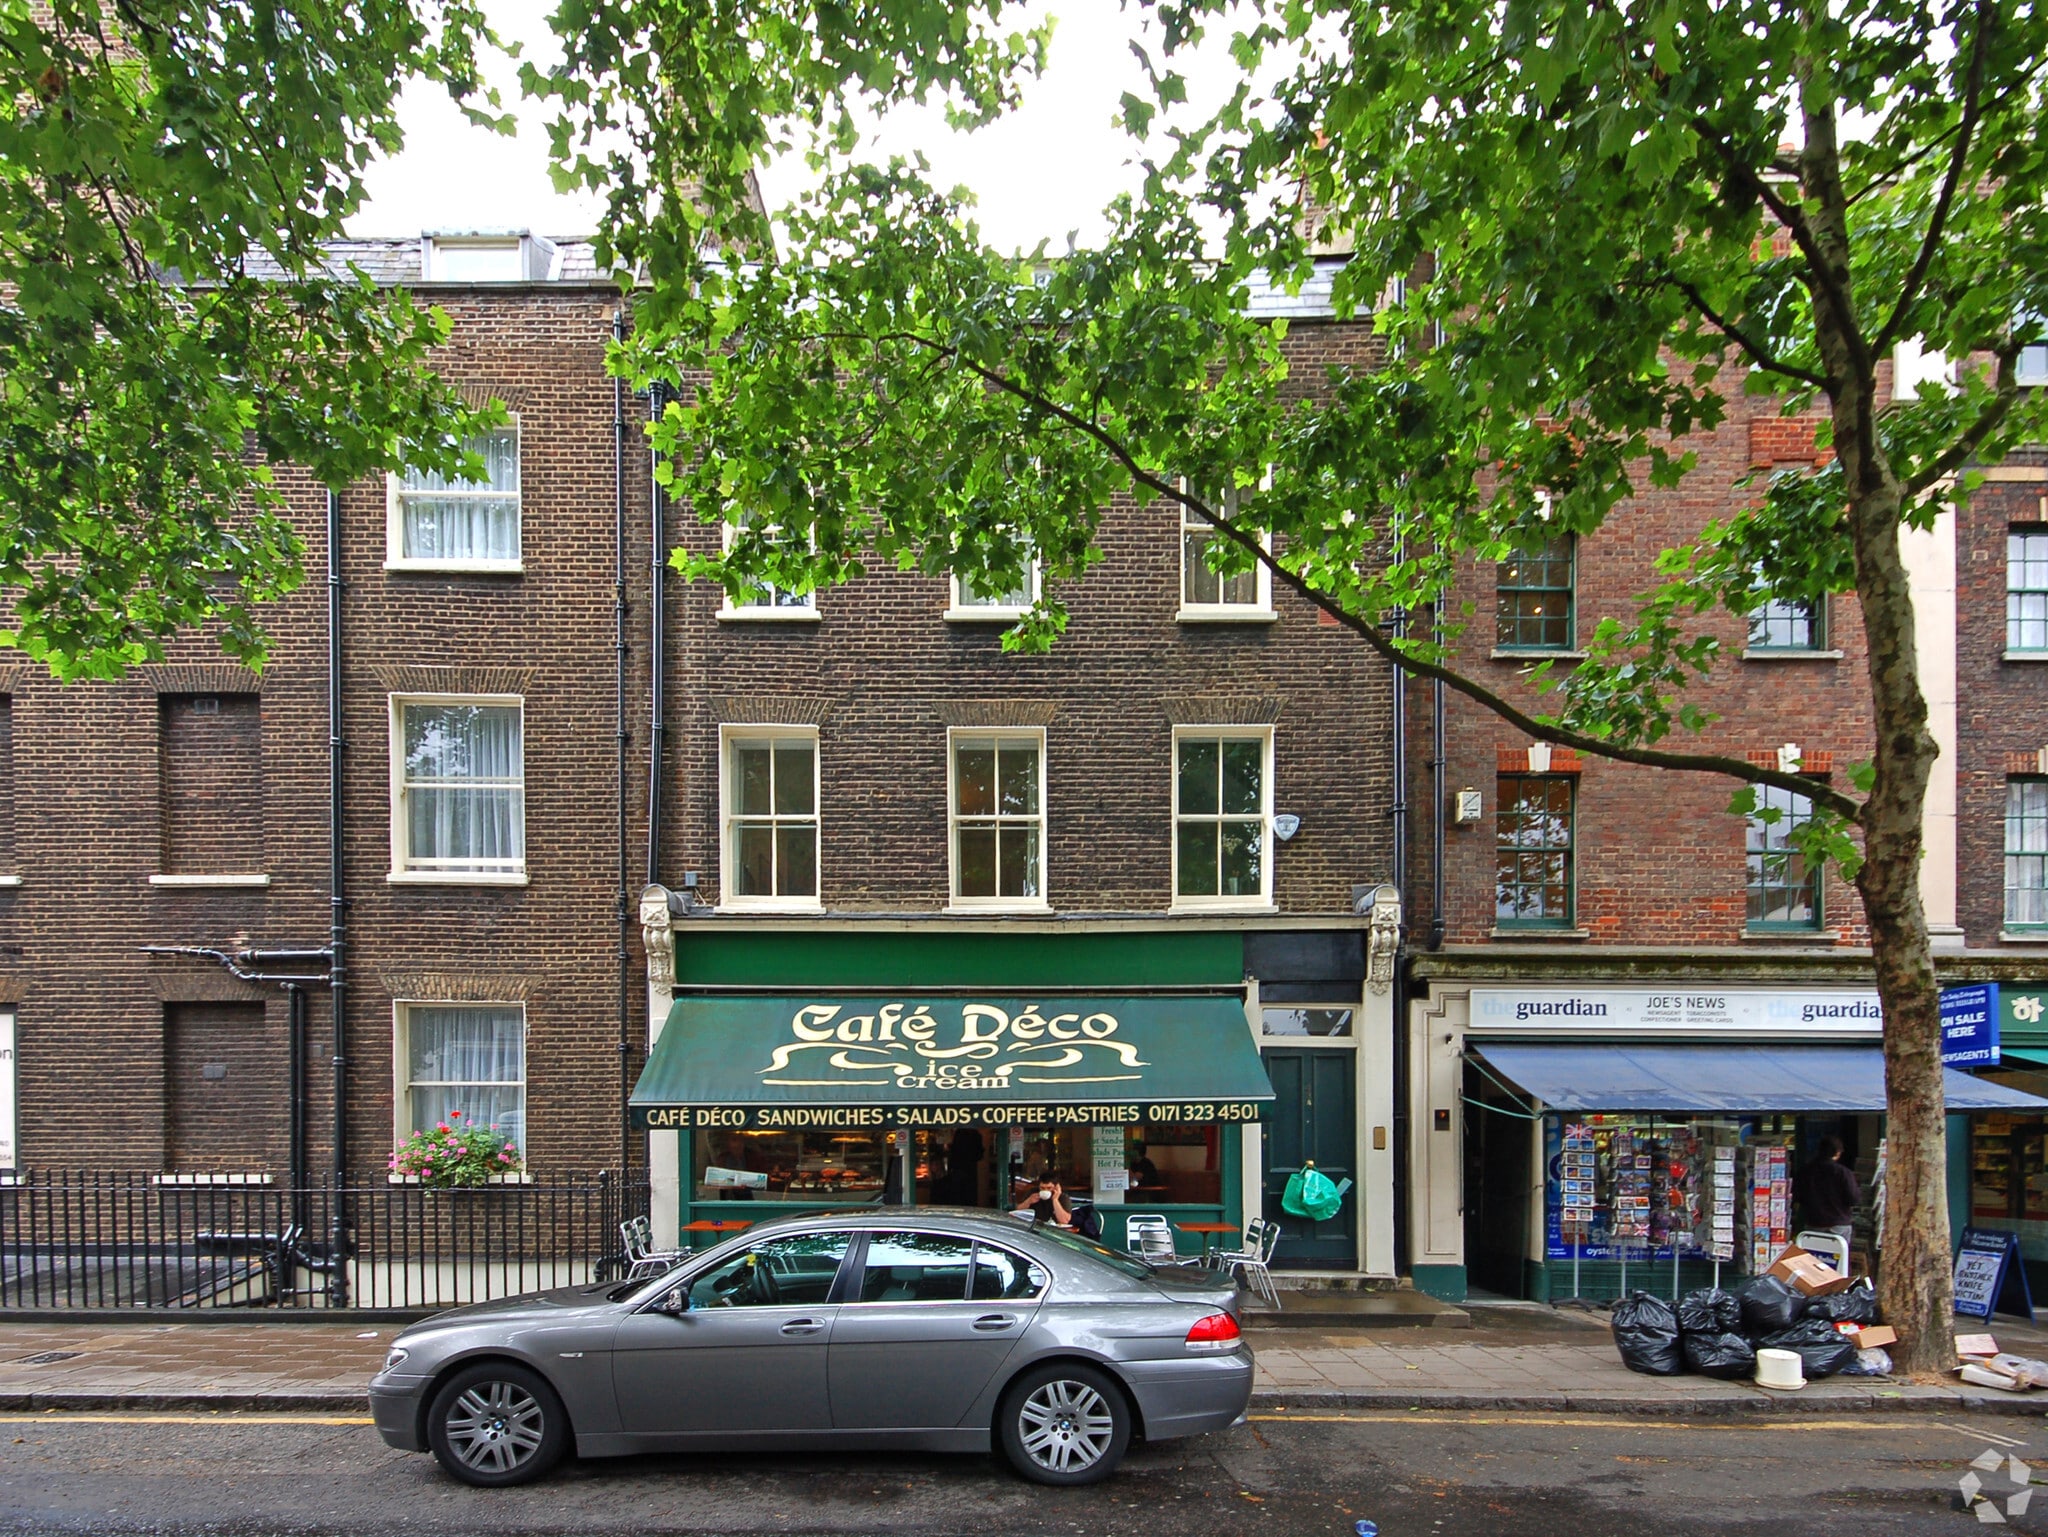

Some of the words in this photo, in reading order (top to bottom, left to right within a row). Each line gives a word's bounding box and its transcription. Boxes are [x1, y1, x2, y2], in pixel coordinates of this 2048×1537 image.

[1516, 999, 1608, 1020] guardian
[1646, 997, 1682, 1008] JOE'S
[1686, 997, 1726, 1009] NEWS
[1802, 1001, 1883, 1021] guardia
[792, 1003, 938, 1042] Café
[960, 1003, 1119, 1041] Déco
[1940, 1015, 1954, 1027] ON
[1955, 1011, 1986, 1026] SALE
[1947, 1025, 1977, 1039] HERE
[925, 1059, 983, 1078] ice
[896, 1074, 1011, 1090] cream
[646, 1106, 690, 1126] CAFÉ
[696, 1106, 746, 1126] DÉCO
[757, 1107, 884, 1126] SANDWICHES
[896, 1107, 971, 1125] SALADS
[982, 1106, 1047, 1124] COFFEE
[1056, 1105, 1140, 1123] PASTRIES
[1148, 1104, 1180, 1122] 0171
[1184, 1104, 1215, 1121] 323
[1217, 1103, 1259, 1121] 4501
[1967, 1261, 1985, 1270] YET
[1958, 1279, 1984, 1291] KNIFE
